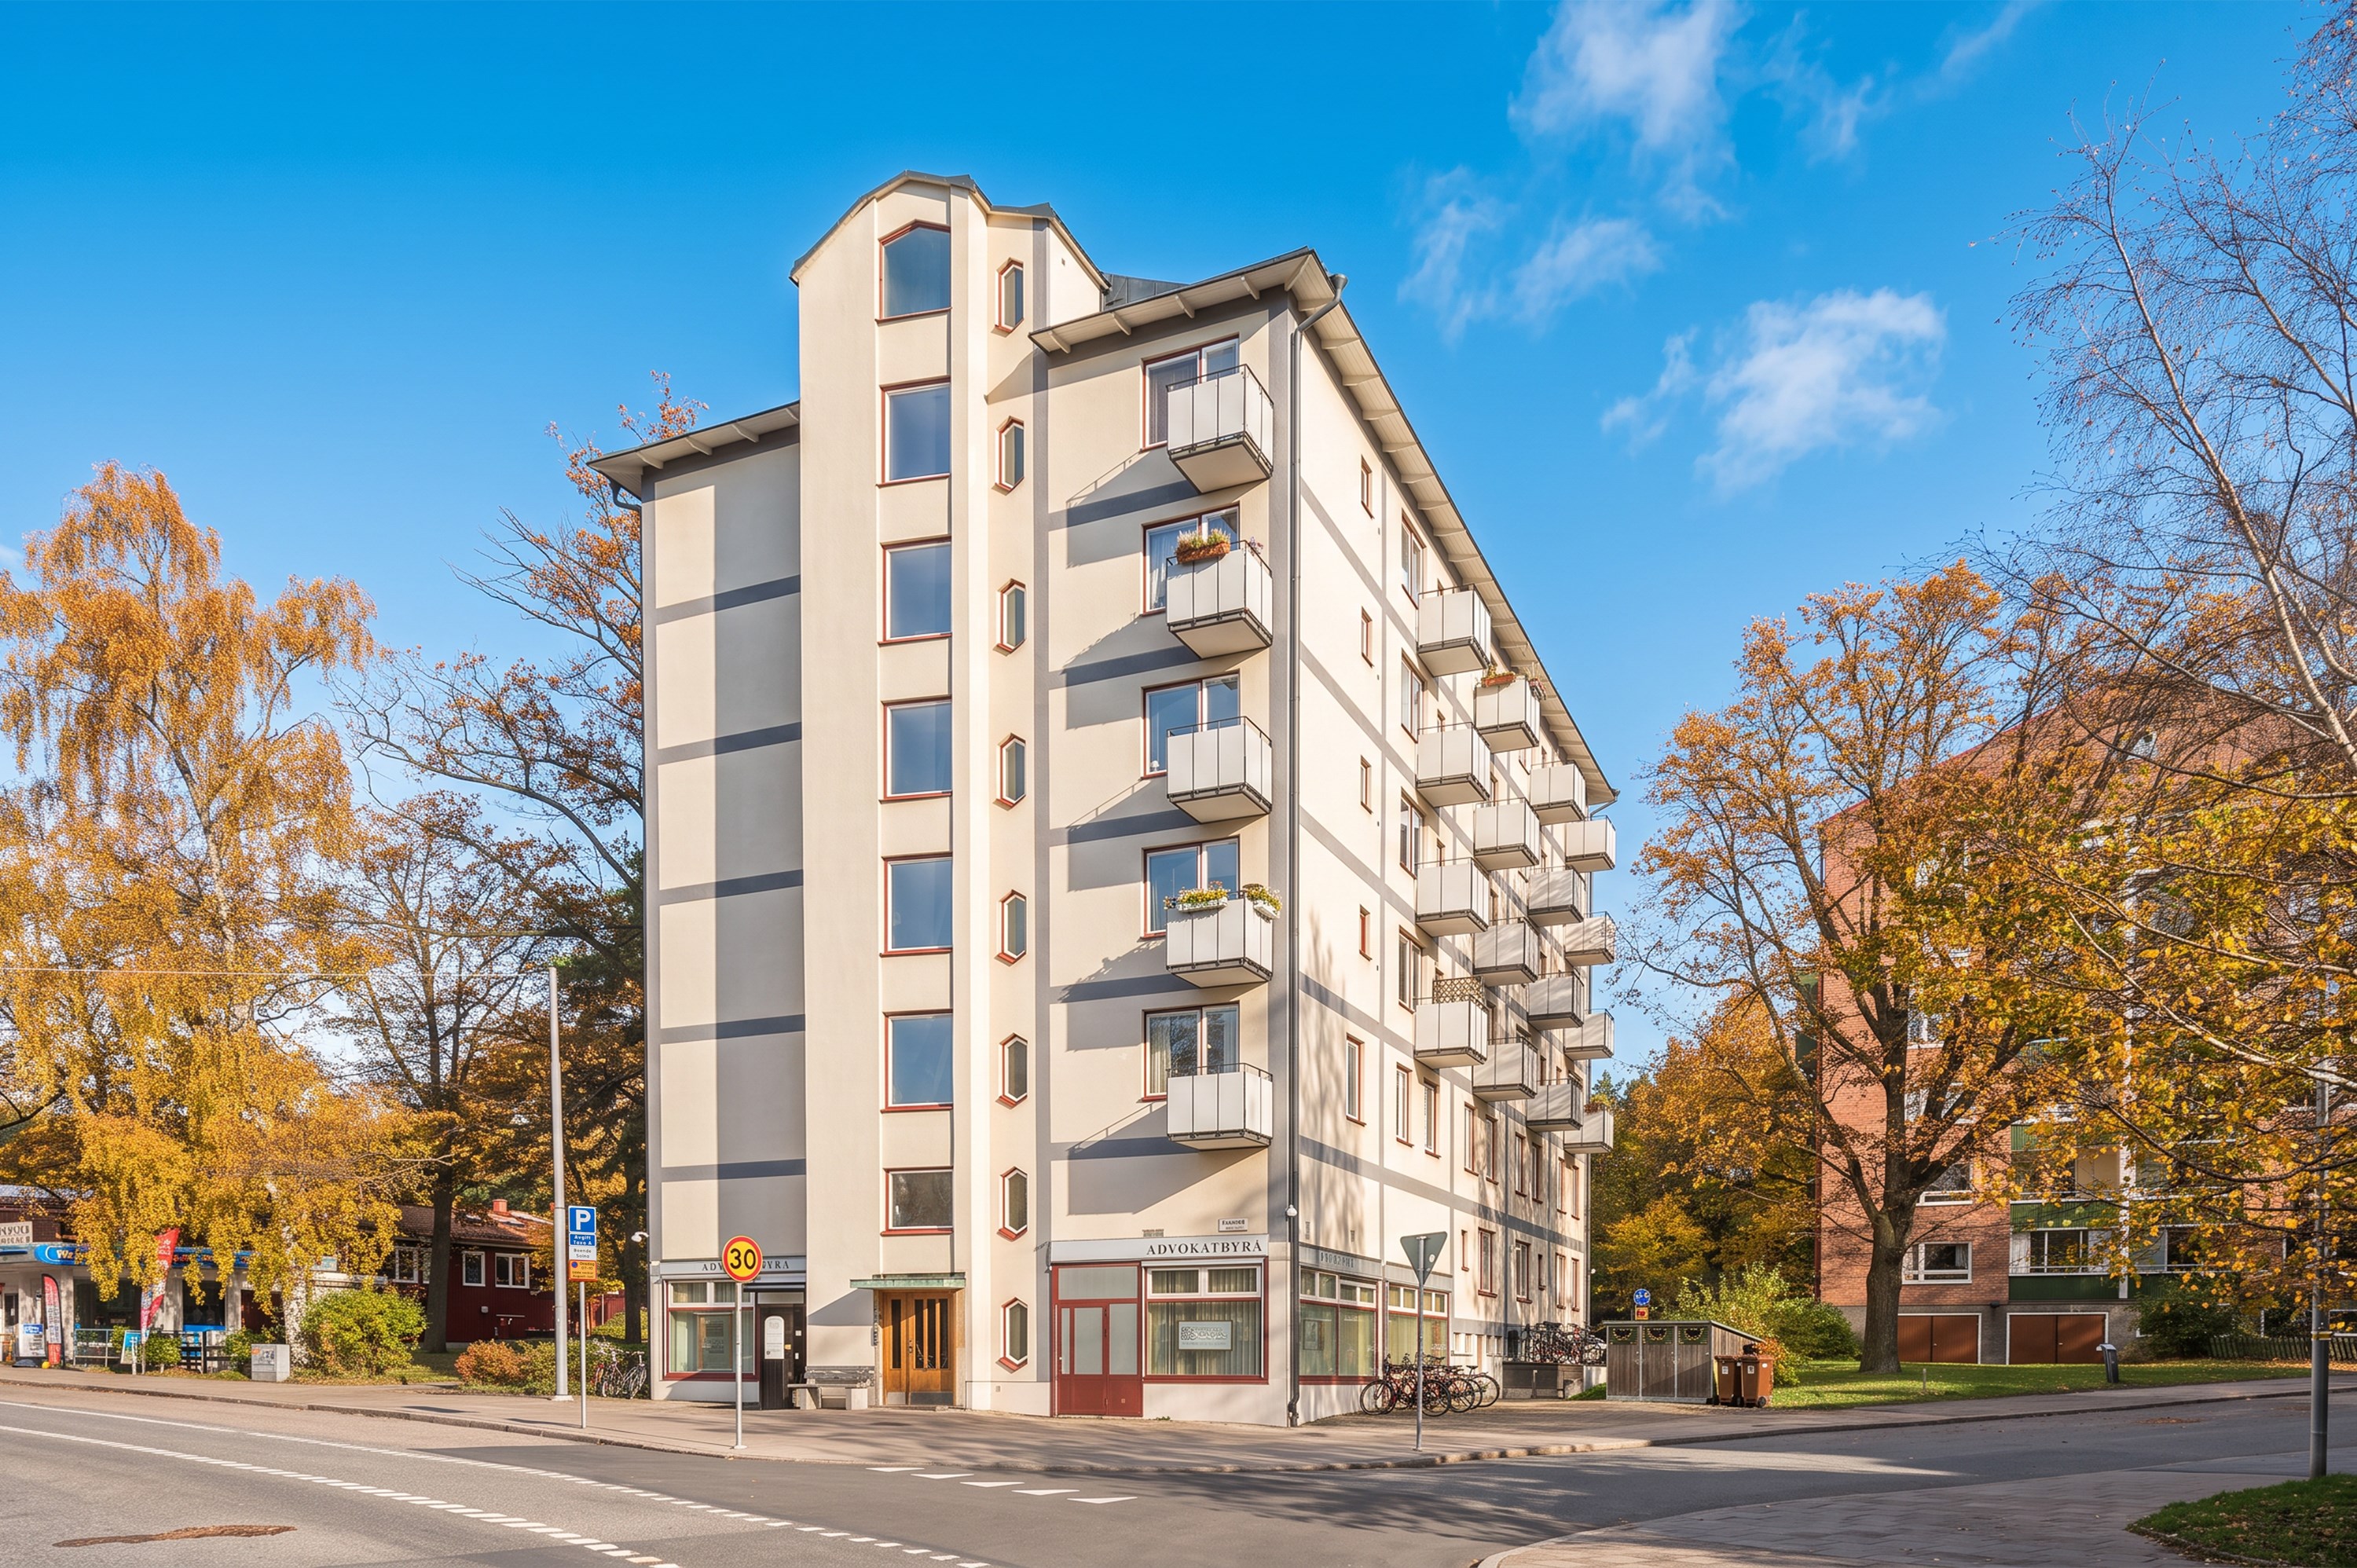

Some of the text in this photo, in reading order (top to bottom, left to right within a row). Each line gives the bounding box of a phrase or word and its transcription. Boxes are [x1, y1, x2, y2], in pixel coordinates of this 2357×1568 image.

[576, 1209, 591, 1230] P
[1146, 1239, 1262, 1255] ADVOKATBYRÅ
[730, 1247, 757, 1270] 30
